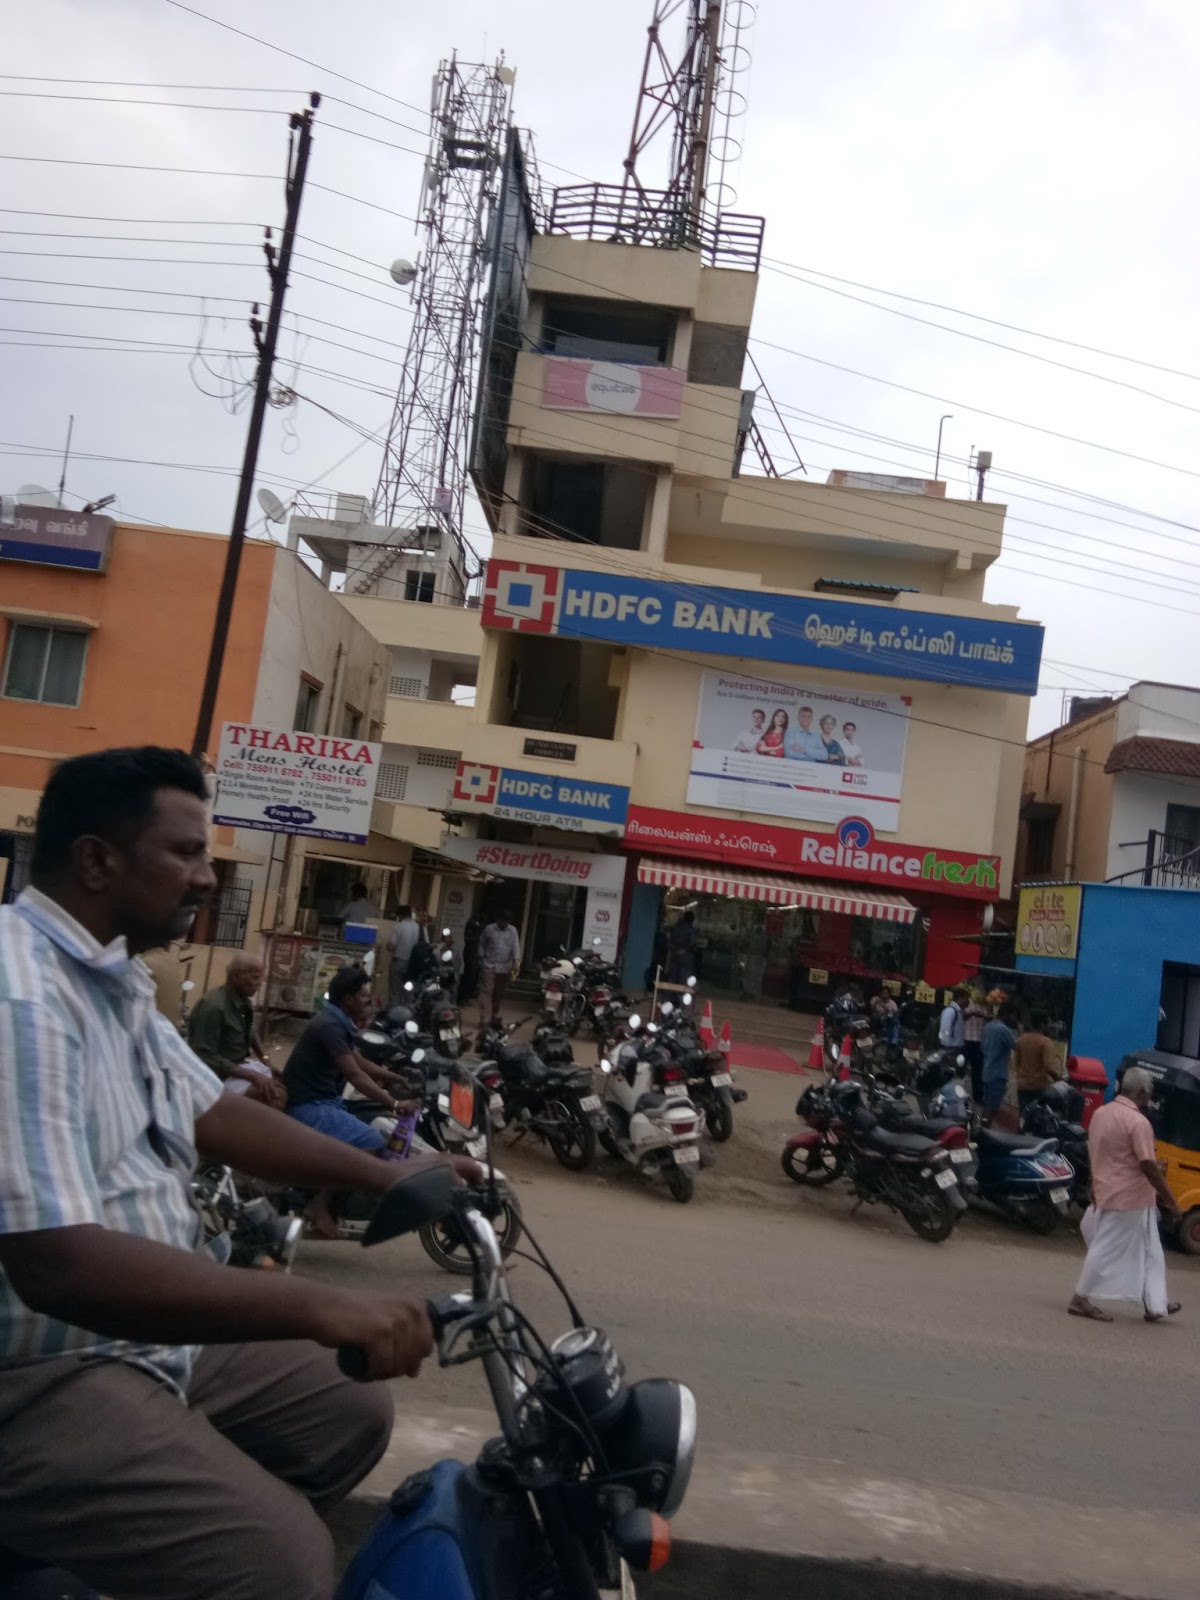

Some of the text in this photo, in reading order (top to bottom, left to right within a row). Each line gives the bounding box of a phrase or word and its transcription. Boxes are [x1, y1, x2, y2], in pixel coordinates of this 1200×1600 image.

[590, 383, 636, 395] equitas
[564, 588, 776, 639] HDFC BANK
[959, 637, 1015, 664] பாங்க்
[718, 678, 768, 695] Protecting
[770, 686, 795, 698] India
[797, 689, 805, 699] is
[814, 692, 848, 704] matter
[849, 695, 859, 706] of
[861, 697, 888, 710] pride.
[227, 725, 373, 765] THARIKA
[231, 748, 366, 777] Mens Hostel
[501, 778, 612, 810] HDFC BANK
[270, 807, 291, 819] Free
[493, 806, 583, 828] 24 HOUR ATM
[475, 846, 593, 880] #StartDoing
[799, 837, 999, 888] Reliance fresh
